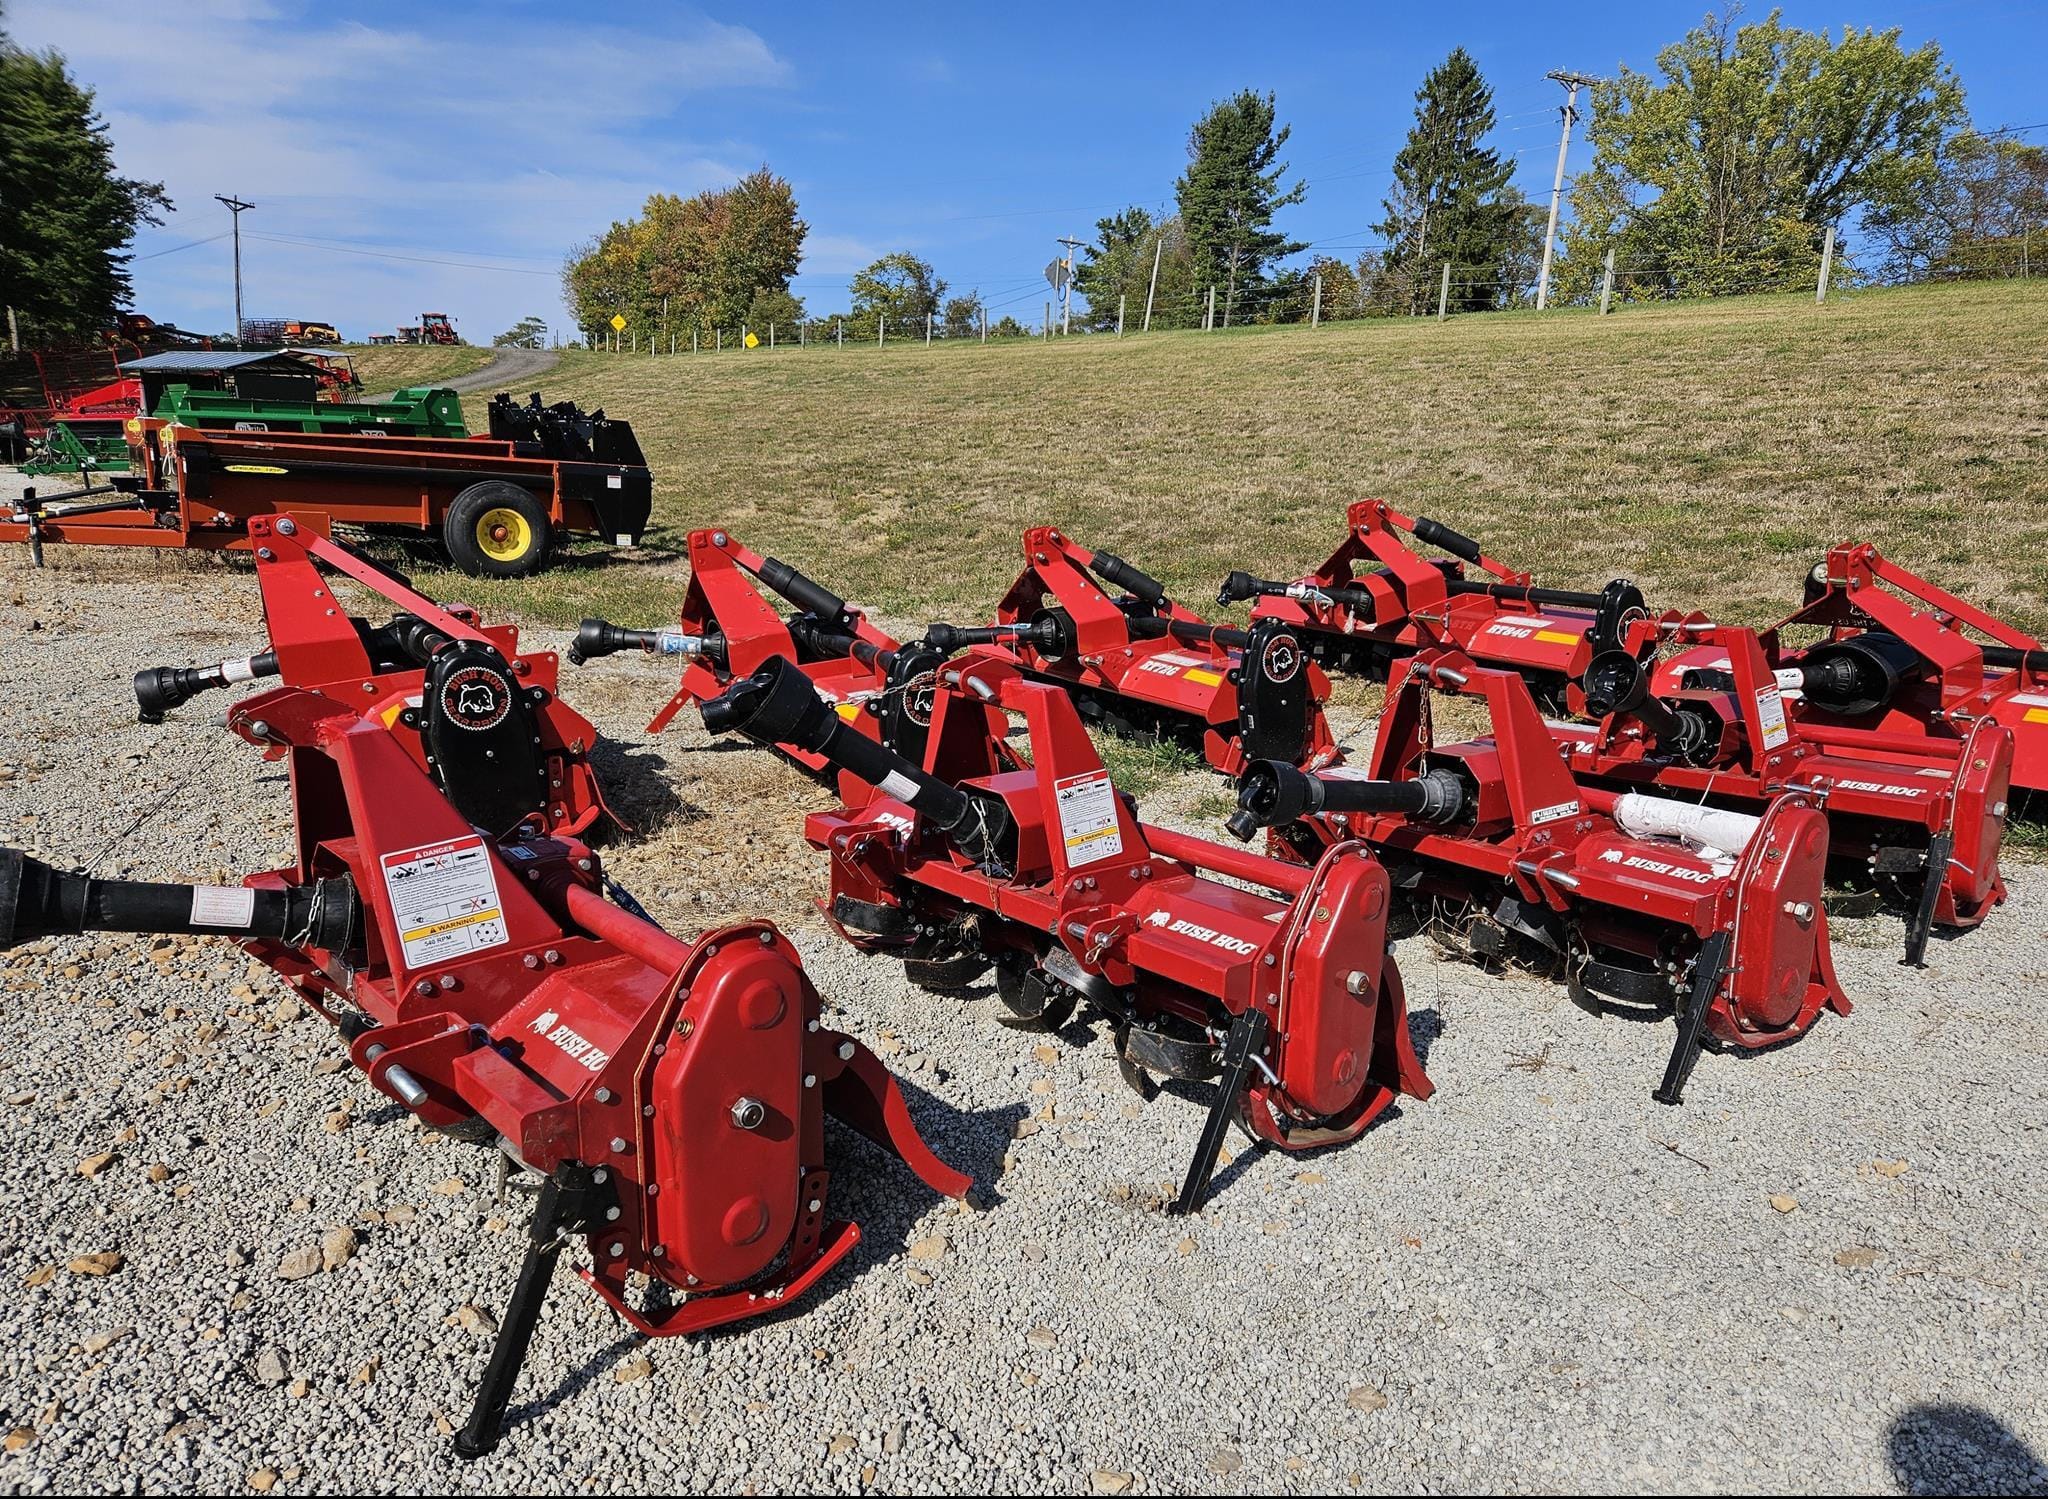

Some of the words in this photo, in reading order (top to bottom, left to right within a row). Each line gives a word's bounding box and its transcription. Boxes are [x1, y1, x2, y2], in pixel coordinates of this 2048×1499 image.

[449, 669, 478, 692] BUSH
[481, 671, 504, 692] HOG
[445, 698, 470, 727] GEAR
[471, 698, 507, 727] DRIVEN
[1836, 780, 1883, 792] BUSH
[422, 845, 455, 858] DANGER
[1623, 856, 1671, 875] BUSH
[1671, 867, 1714, 884] HOG
[438, 917, 475, 932] WARNING
[424, 938, 436, 947] 540
[437, 934, 452, 943] RPM
[1168, 920, 1219, 942] BUSH
[1210, 934, 1259, 956] HOG
[545, 1024, 593, 1058] BUSH
[578, 1048, 610, 1071] HO
